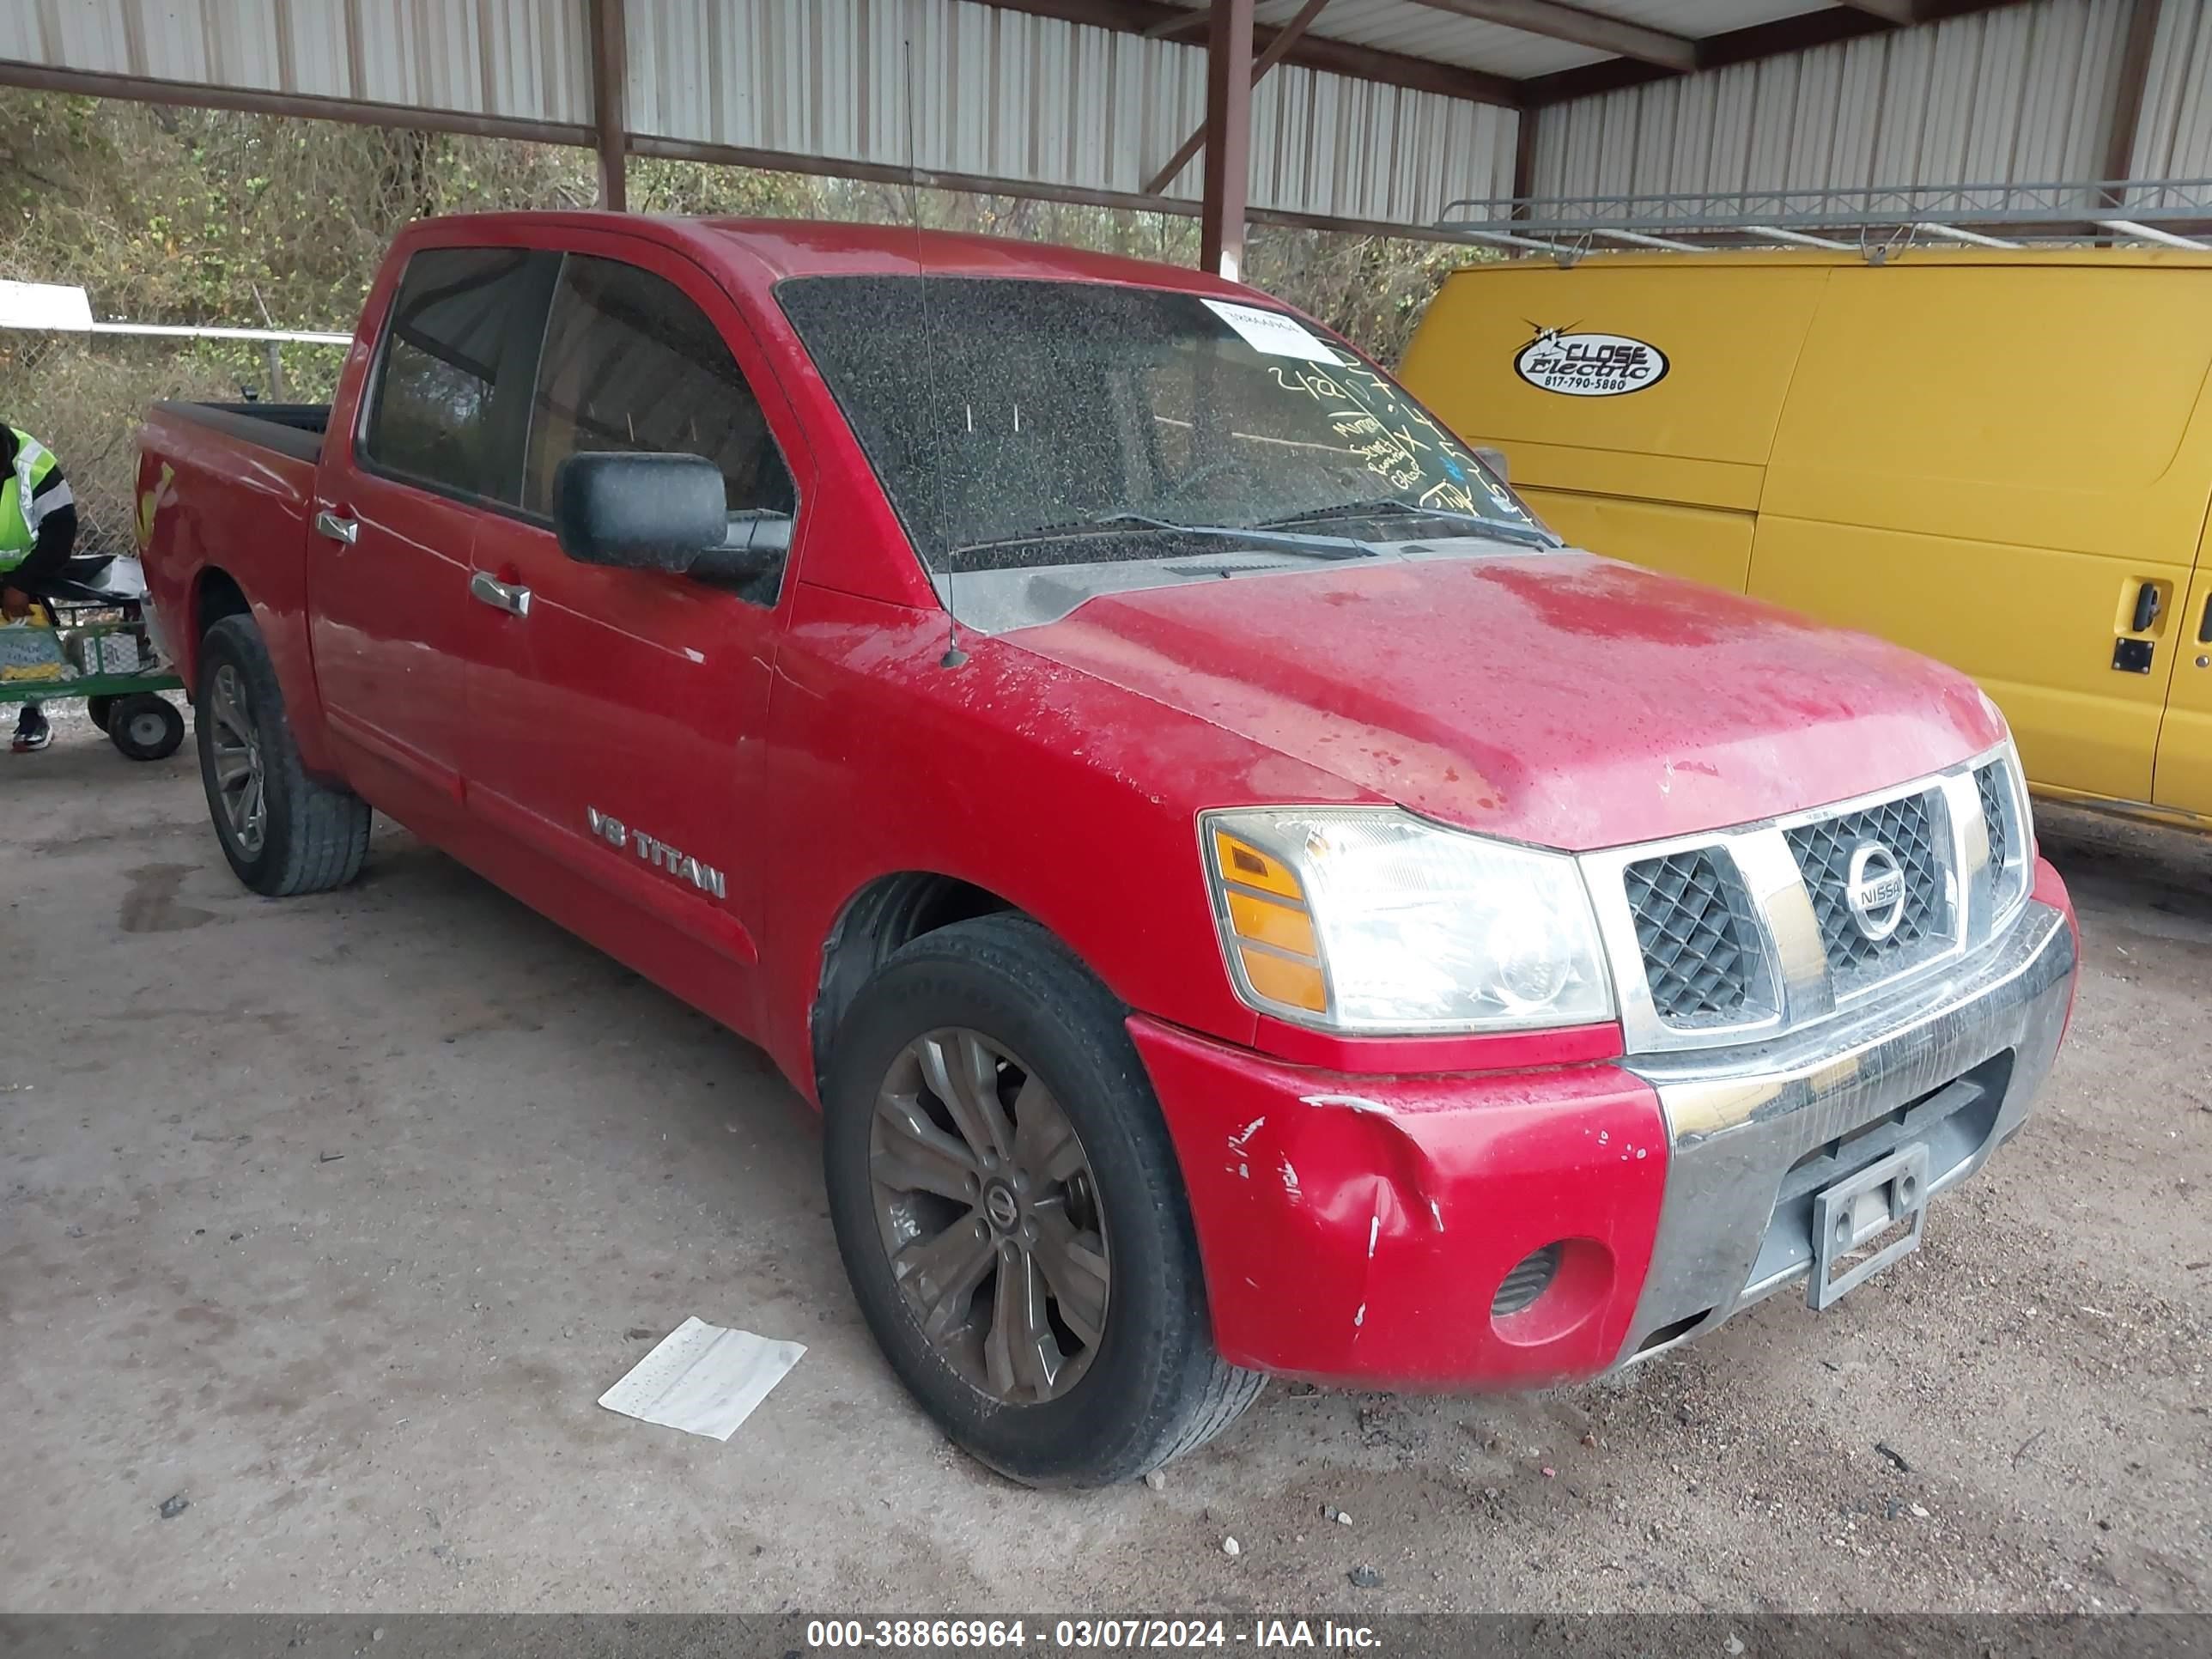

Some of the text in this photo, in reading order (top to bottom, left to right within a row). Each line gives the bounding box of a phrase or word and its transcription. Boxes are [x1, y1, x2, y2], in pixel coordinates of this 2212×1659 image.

[1565, 343, 1647, 364] CLOSE
[1527, 359, 1650, 379] Electric
[1545, 376, 1625, 390] 817-790-5880
[588, 805, 725, 899] V8 TITAN
